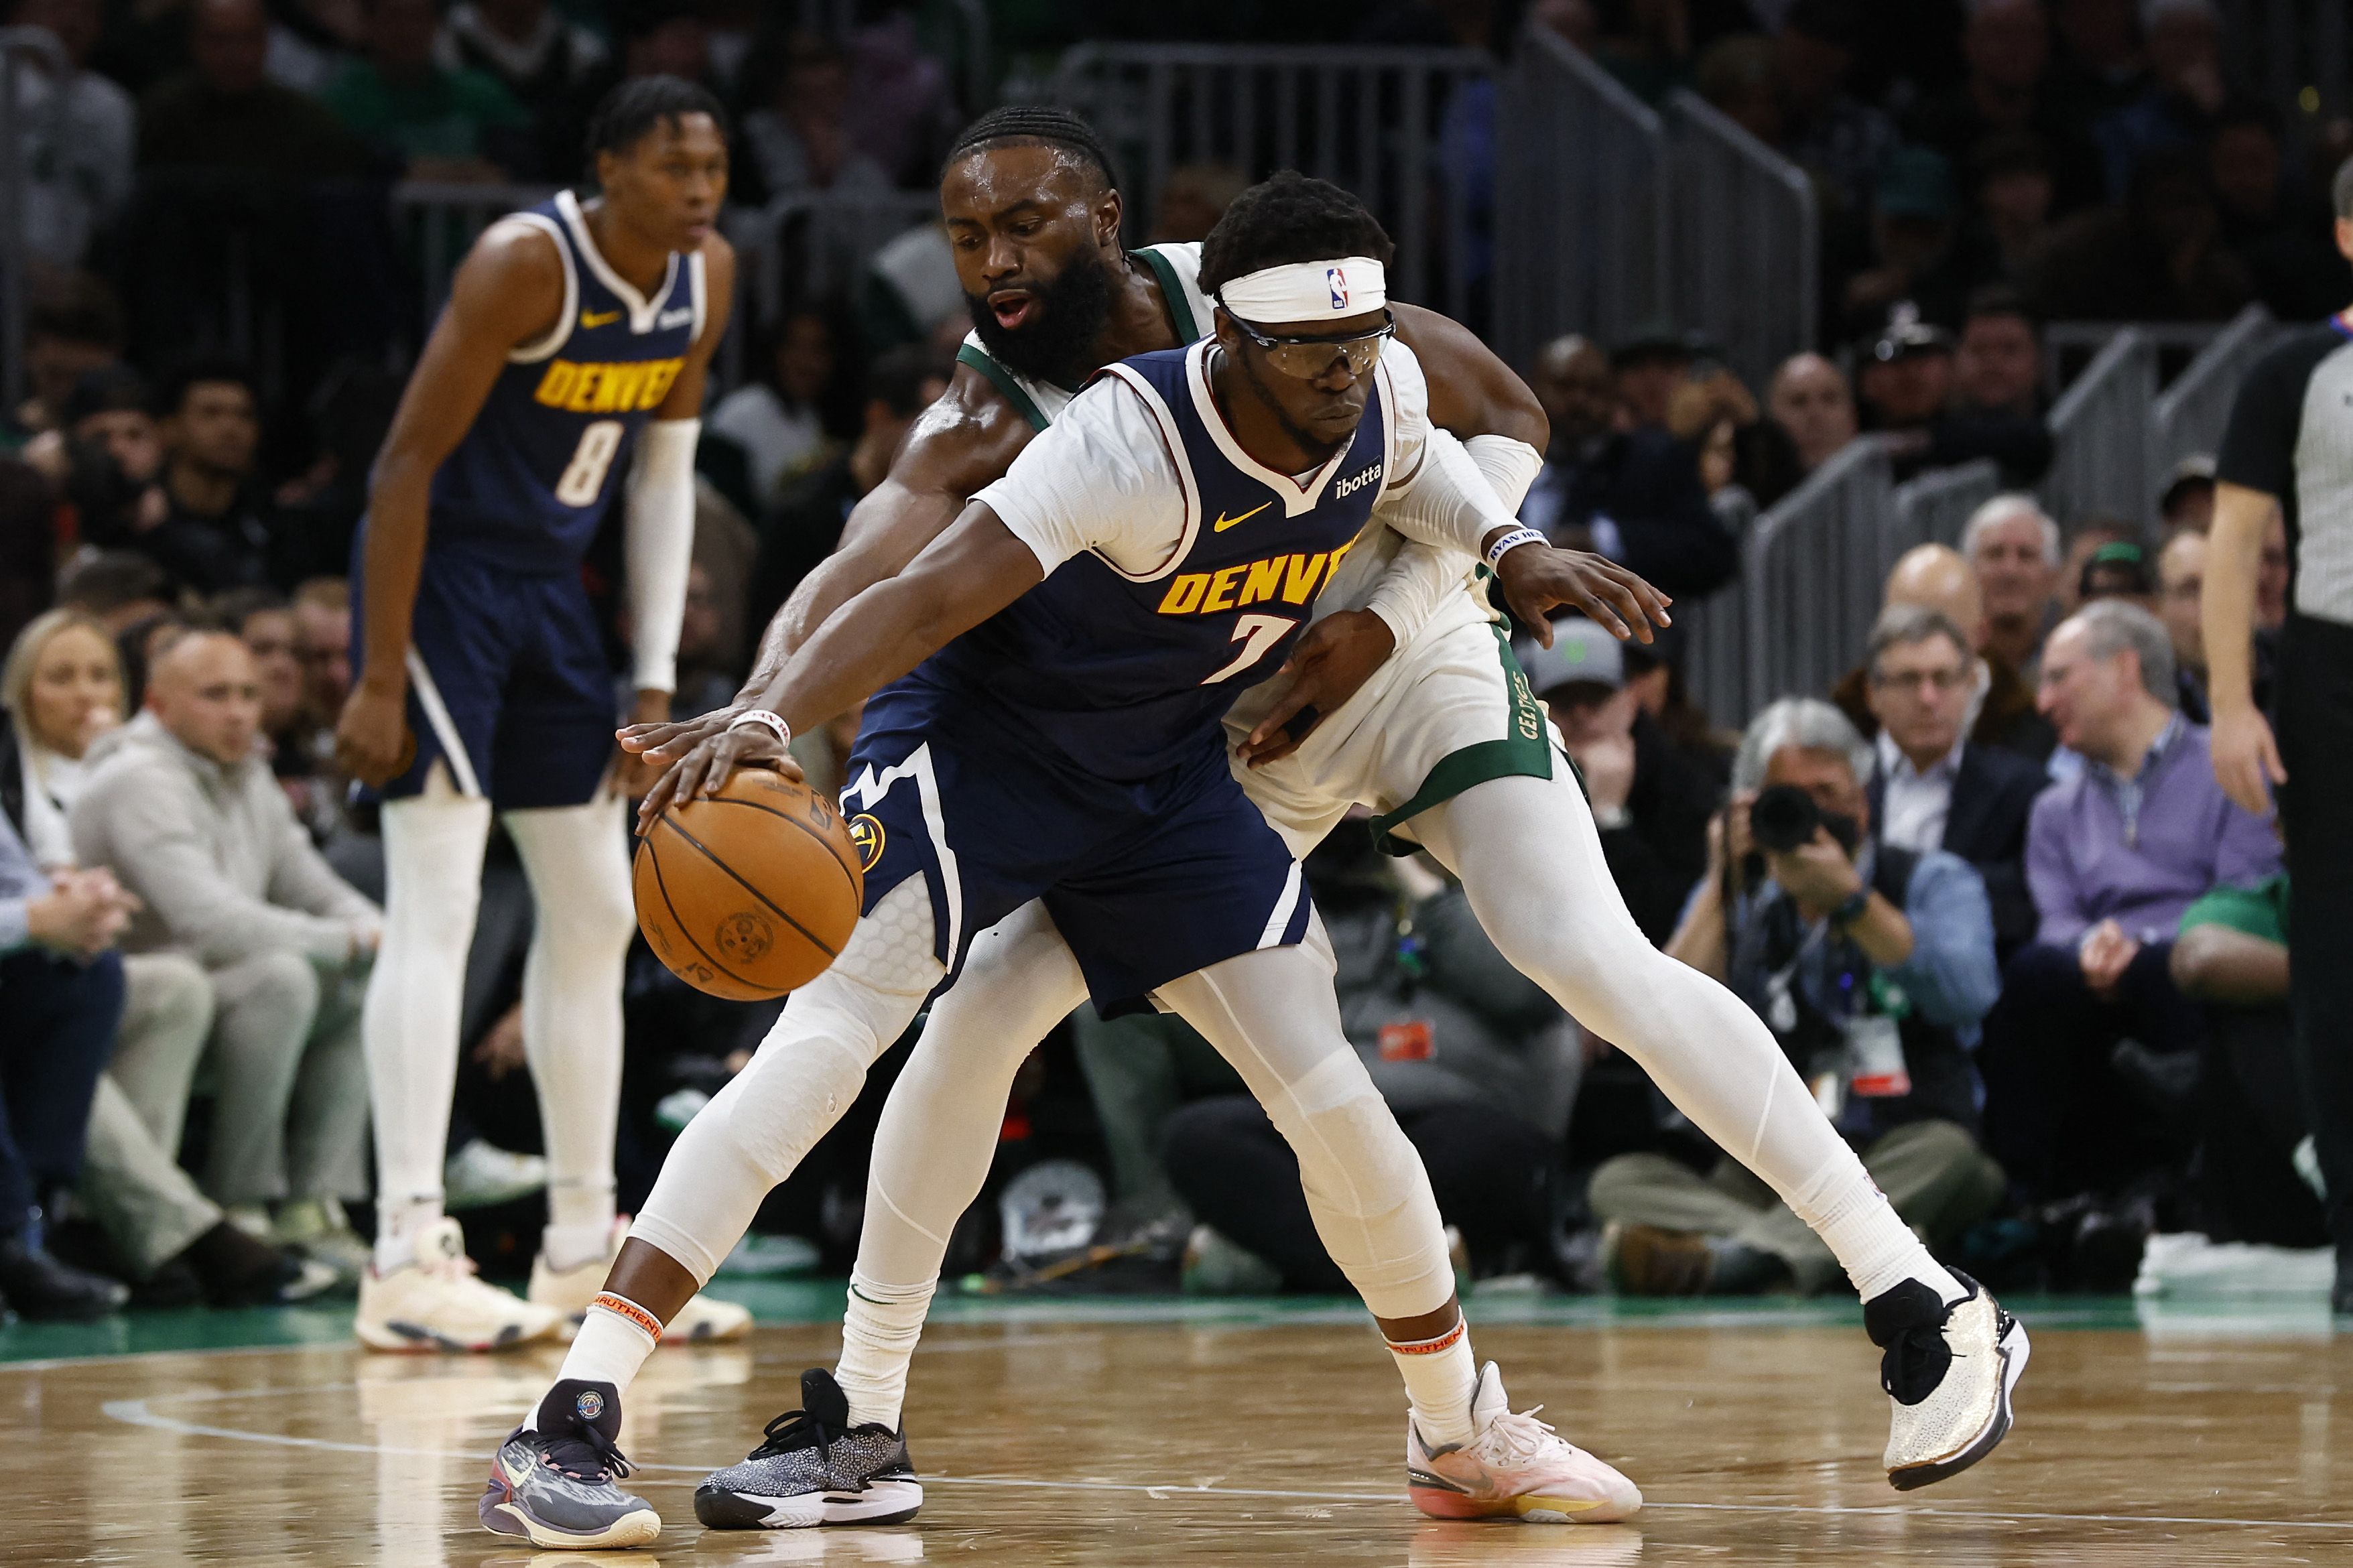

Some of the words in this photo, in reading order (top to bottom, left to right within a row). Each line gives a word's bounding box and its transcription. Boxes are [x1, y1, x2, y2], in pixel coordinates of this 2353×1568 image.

[533, 357, 685, 413] DENVER
[555, 419, 625, 508] 8
[1336, 464, 1381, 500] ibotta
[1490, 534, 1520, 560] RYAN
[1200, 614, 1301, 685] 7
[1513, 670, 1539, 740] CELTICS
